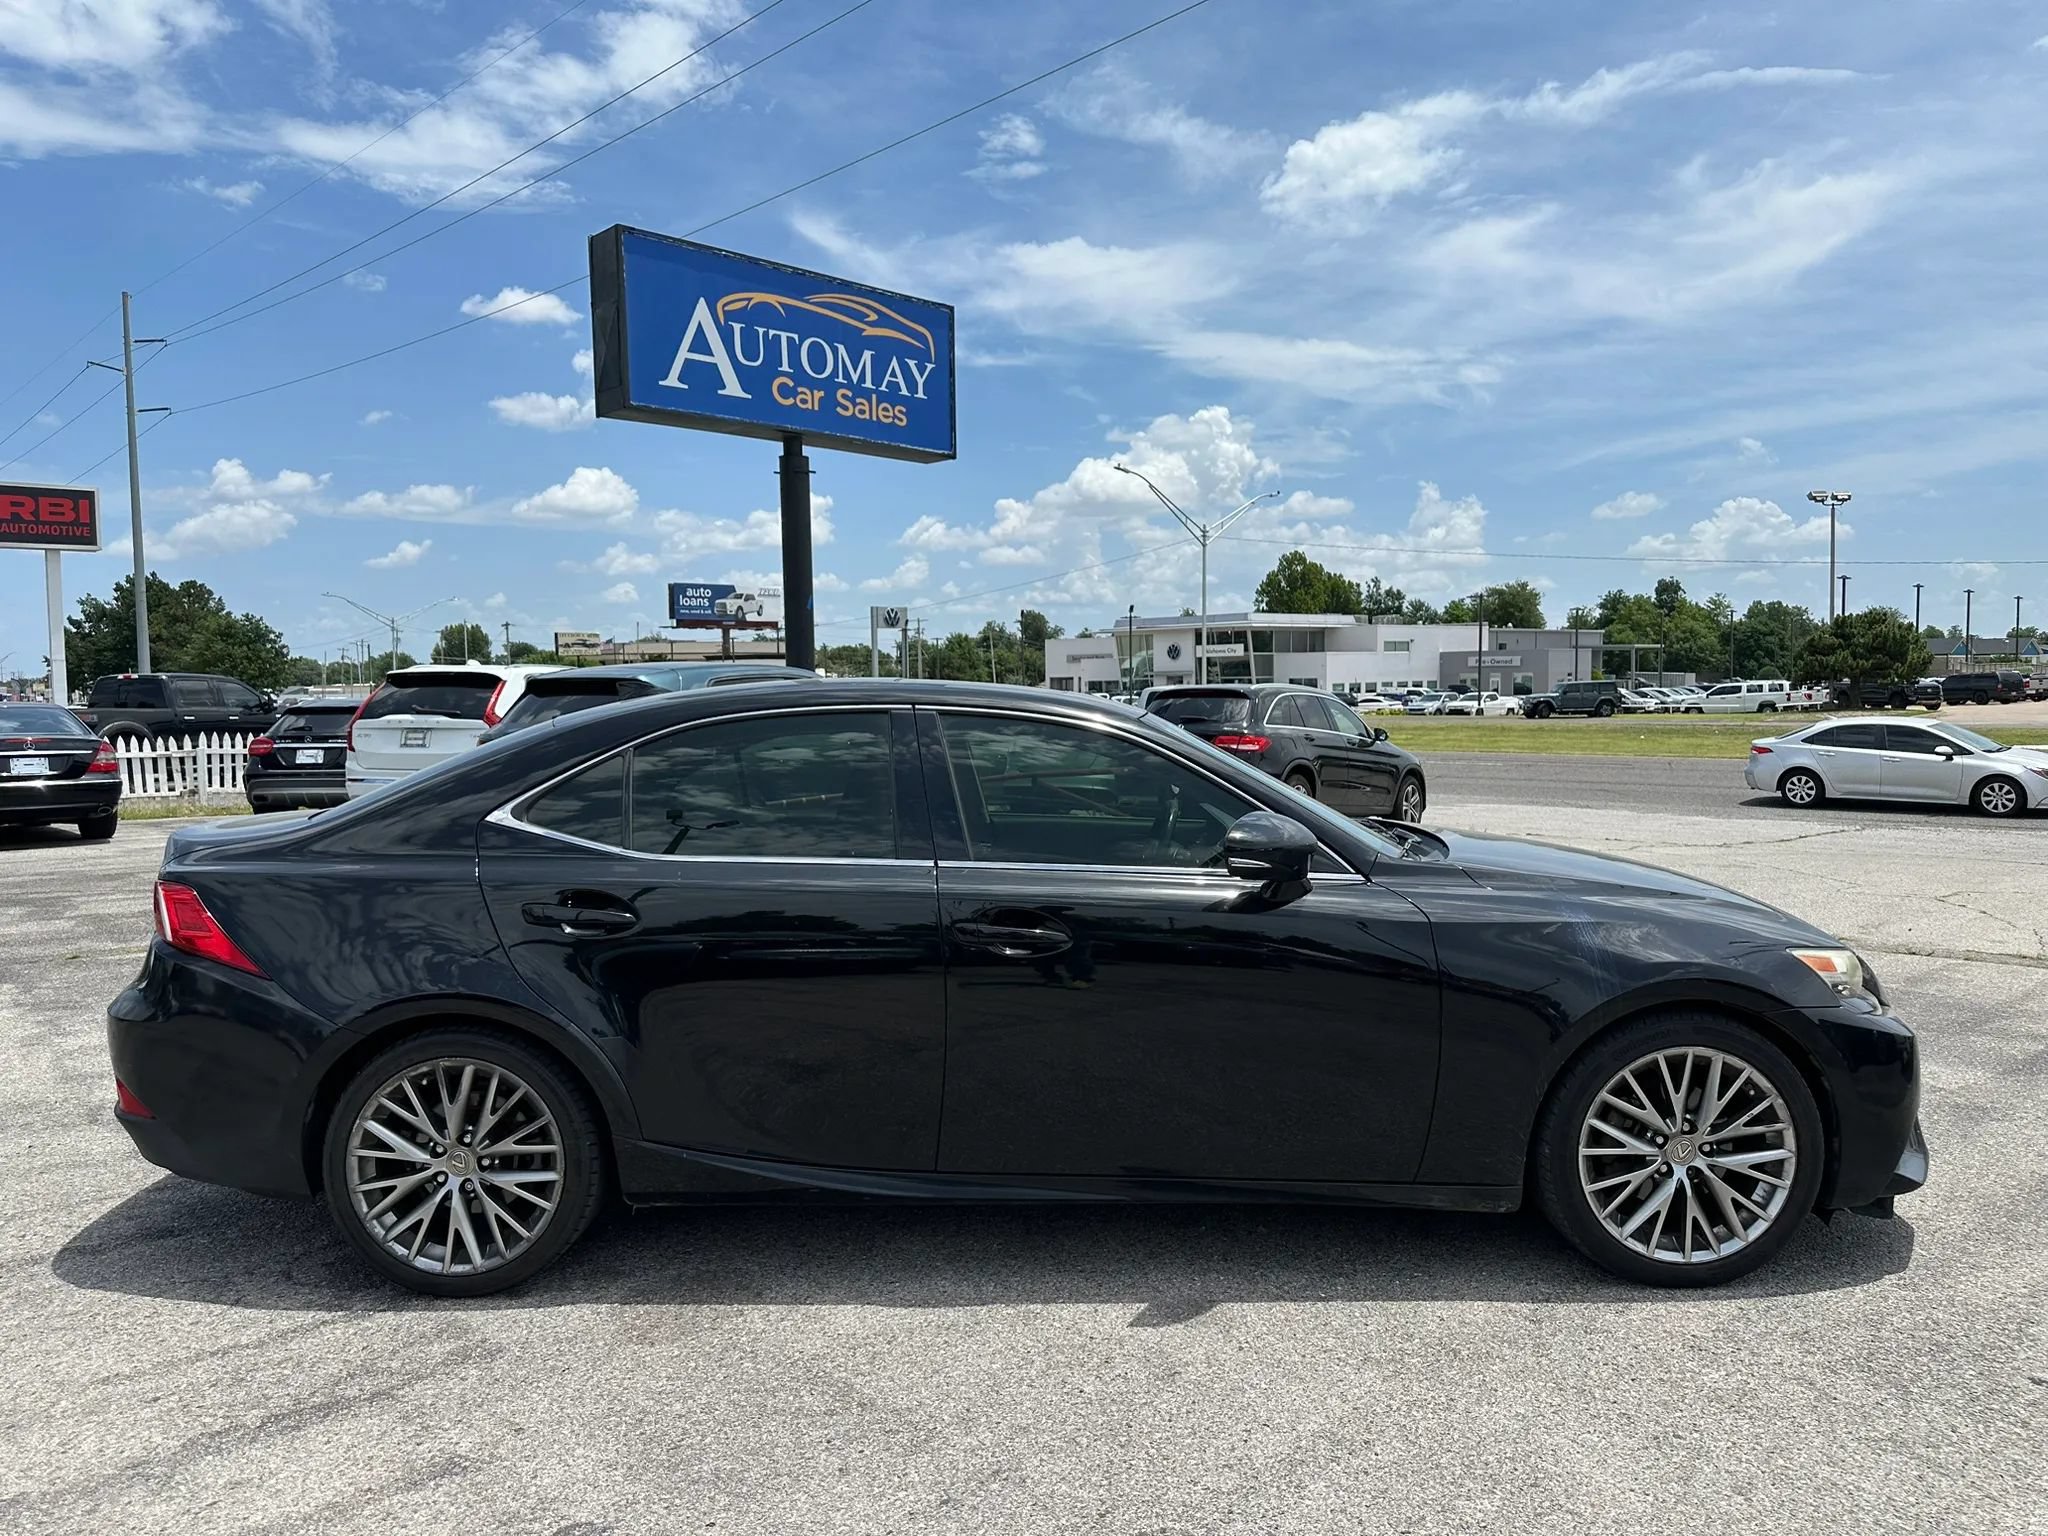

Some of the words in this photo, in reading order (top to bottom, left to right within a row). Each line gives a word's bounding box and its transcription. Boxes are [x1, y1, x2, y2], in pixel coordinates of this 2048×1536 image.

[771, 376, 824, 411] Car
[836, 388, 908, 427] Sales
[0, 494, 90, 523] RBI
[0, 523, 91, 537] AUTOMOTIVE
[686, 587, 712, 597] auto
[679, 594, 710, 606] loans
